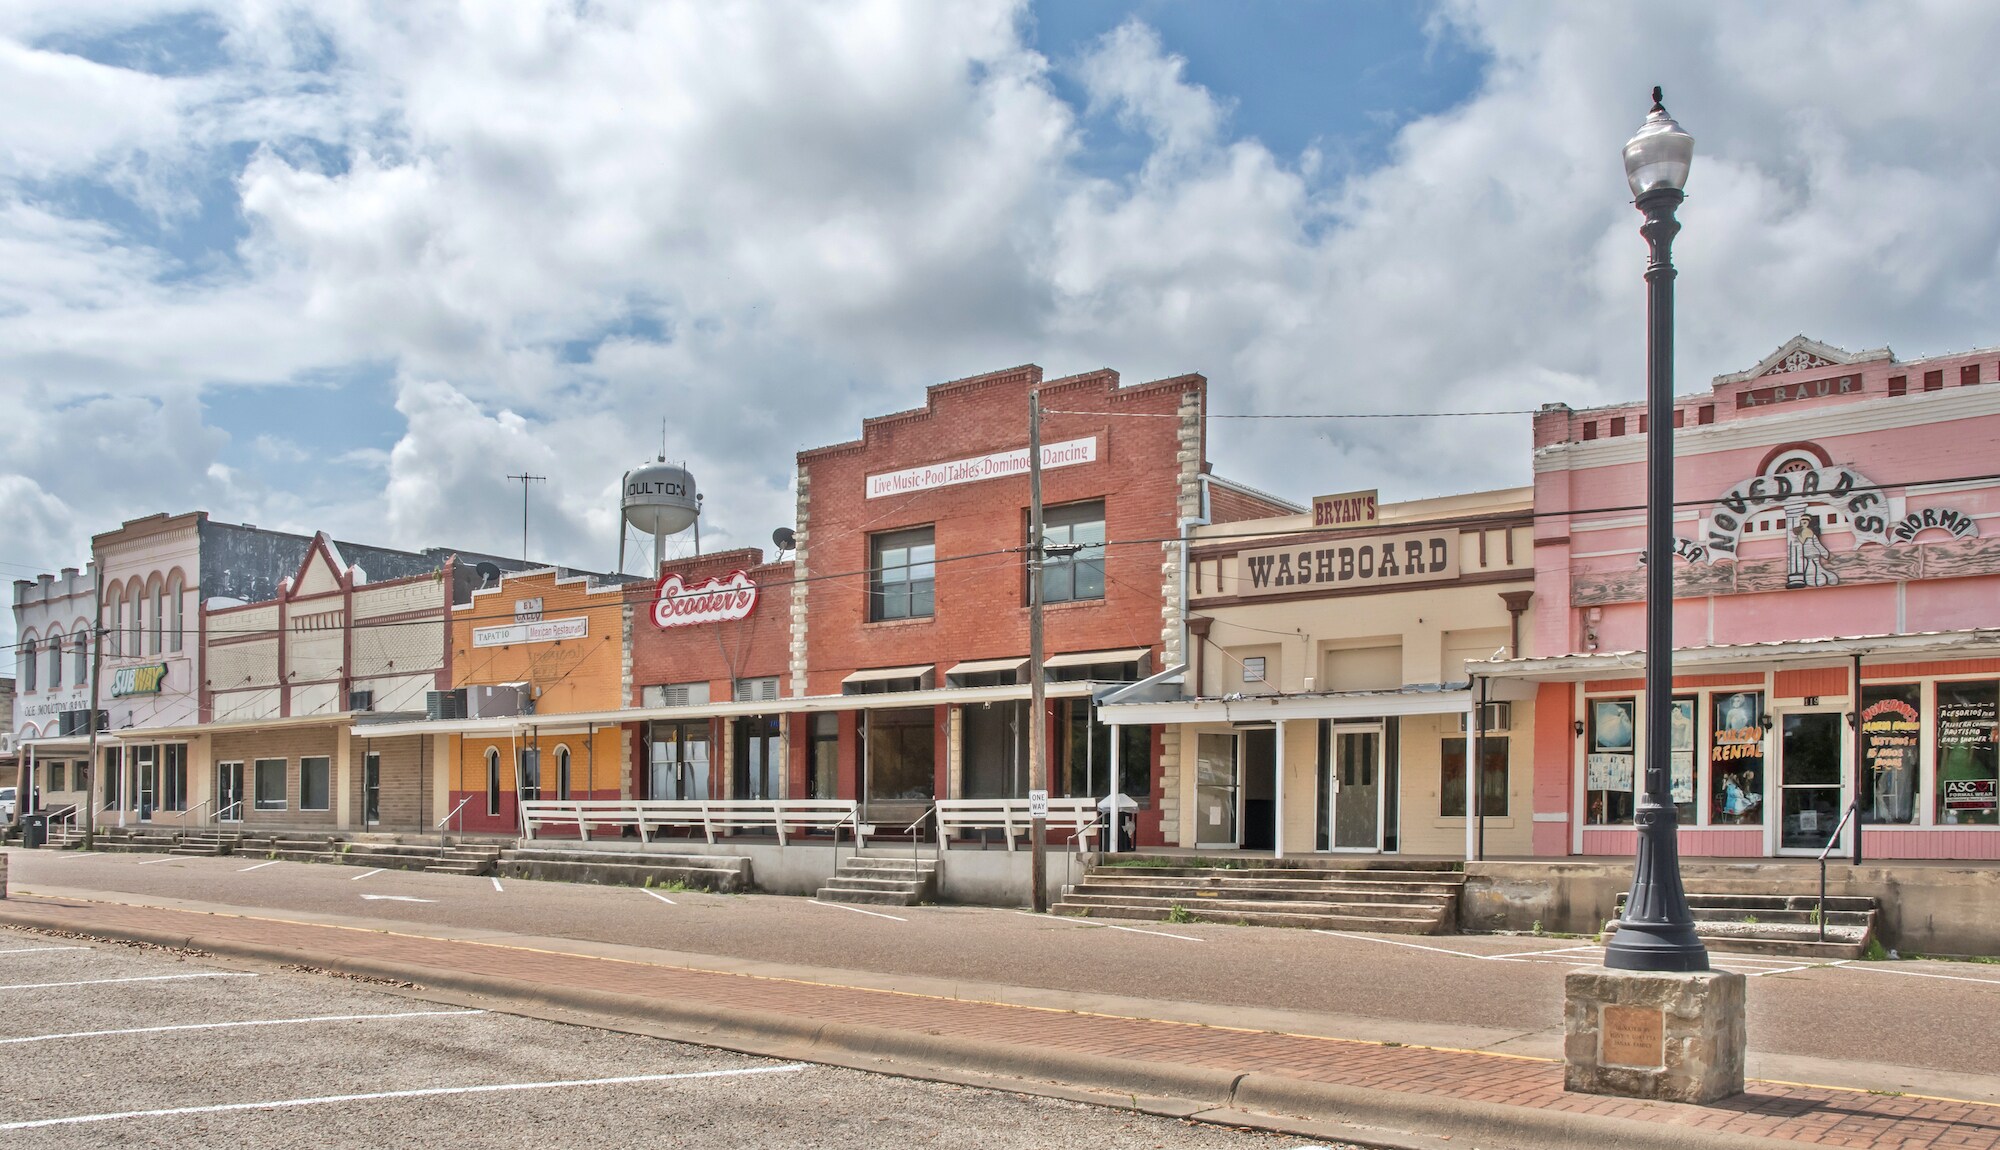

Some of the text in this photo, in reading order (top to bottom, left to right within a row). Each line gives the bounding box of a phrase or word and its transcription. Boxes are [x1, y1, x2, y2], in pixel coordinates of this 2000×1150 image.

[1774, 376, 1852, 403] BAUR
[874, 443, 1088, 494] Live Music Pool Tables Dominoe Dancing
[1315, 496, 1375, 526] BRYAN'S
[1708, 471, 1884, 552] NOVEDADES
[1895, 508, 1972, 540] NORMA
[1247, 537, 1447, 589] WASHBOARD
[523, 601, 534, 610] EL
[660, 582, 752, 618] Scooter's
[478, 630, 510, 642] TAPATIO
[530, 626, 552, 638] Mexican
[111, 666, 164, 695] SUBWAY
[1804, 696, 1819, 706] 119
[1714, 726, 1763, 742] TUXEDO
[1944, 728, 1980, 736] BAUTISMO
[1960, 735, 1987, 744] SHOWER
[1712, 744, 1764, 762] RENTAL
